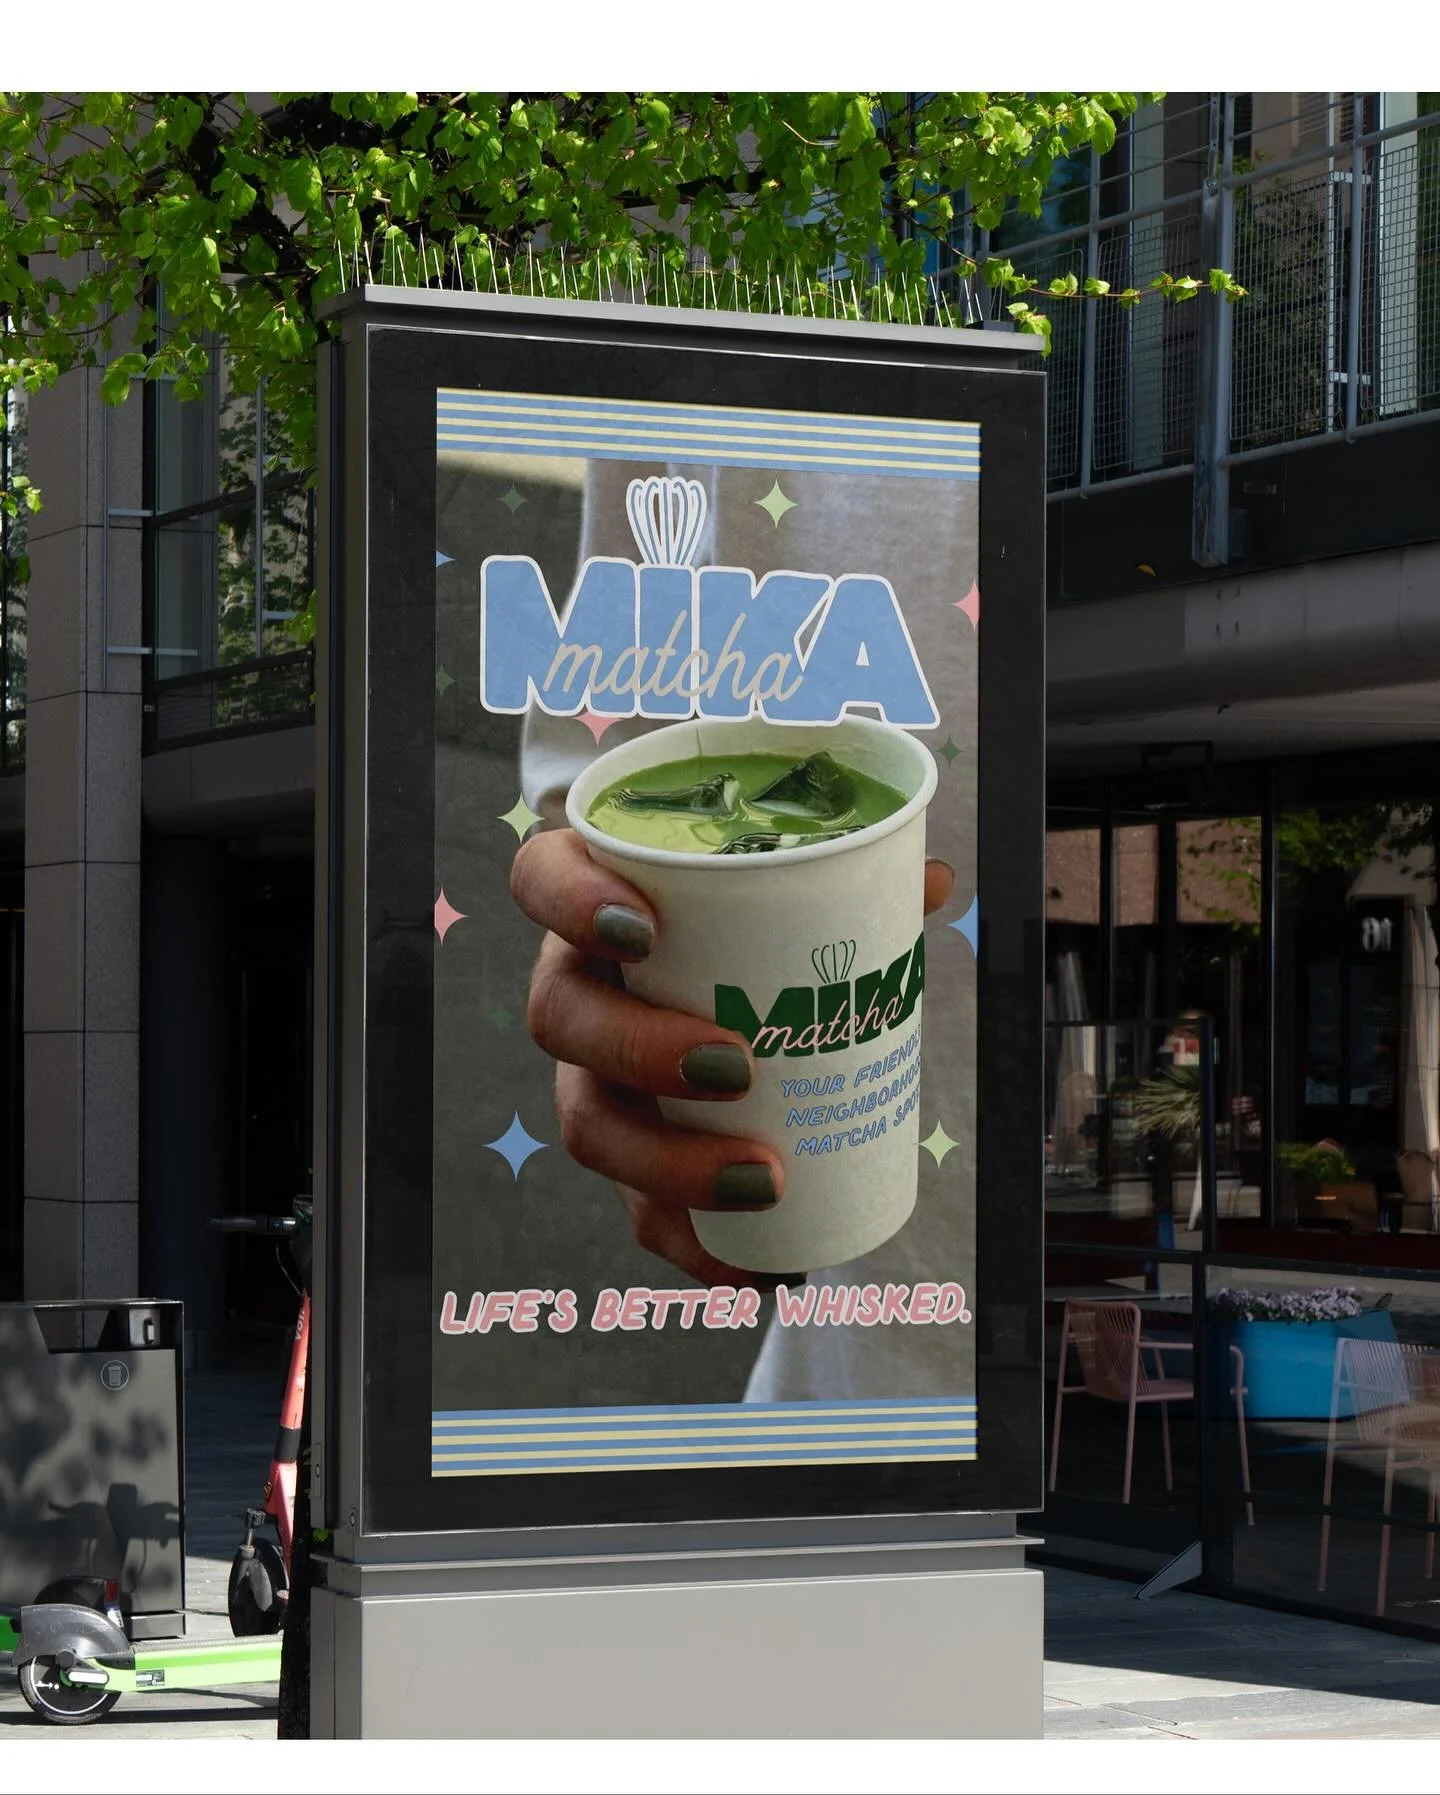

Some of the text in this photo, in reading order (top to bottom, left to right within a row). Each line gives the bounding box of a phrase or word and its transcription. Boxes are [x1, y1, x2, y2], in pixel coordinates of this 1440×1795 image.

[481, 556, 939, 728] MIKA
[543, 609, 804, 702] matcha
[714, 931, 924, 1058] MIKA
[752, 989, 903, 1050] matcha
[781, 1024, 921, 1098] YOUR FRIENDL
[795, 1116, 888, 1156] MATCHA
[439, 1282, 972, 1334] LIFE'S BETTER WHISKED.
